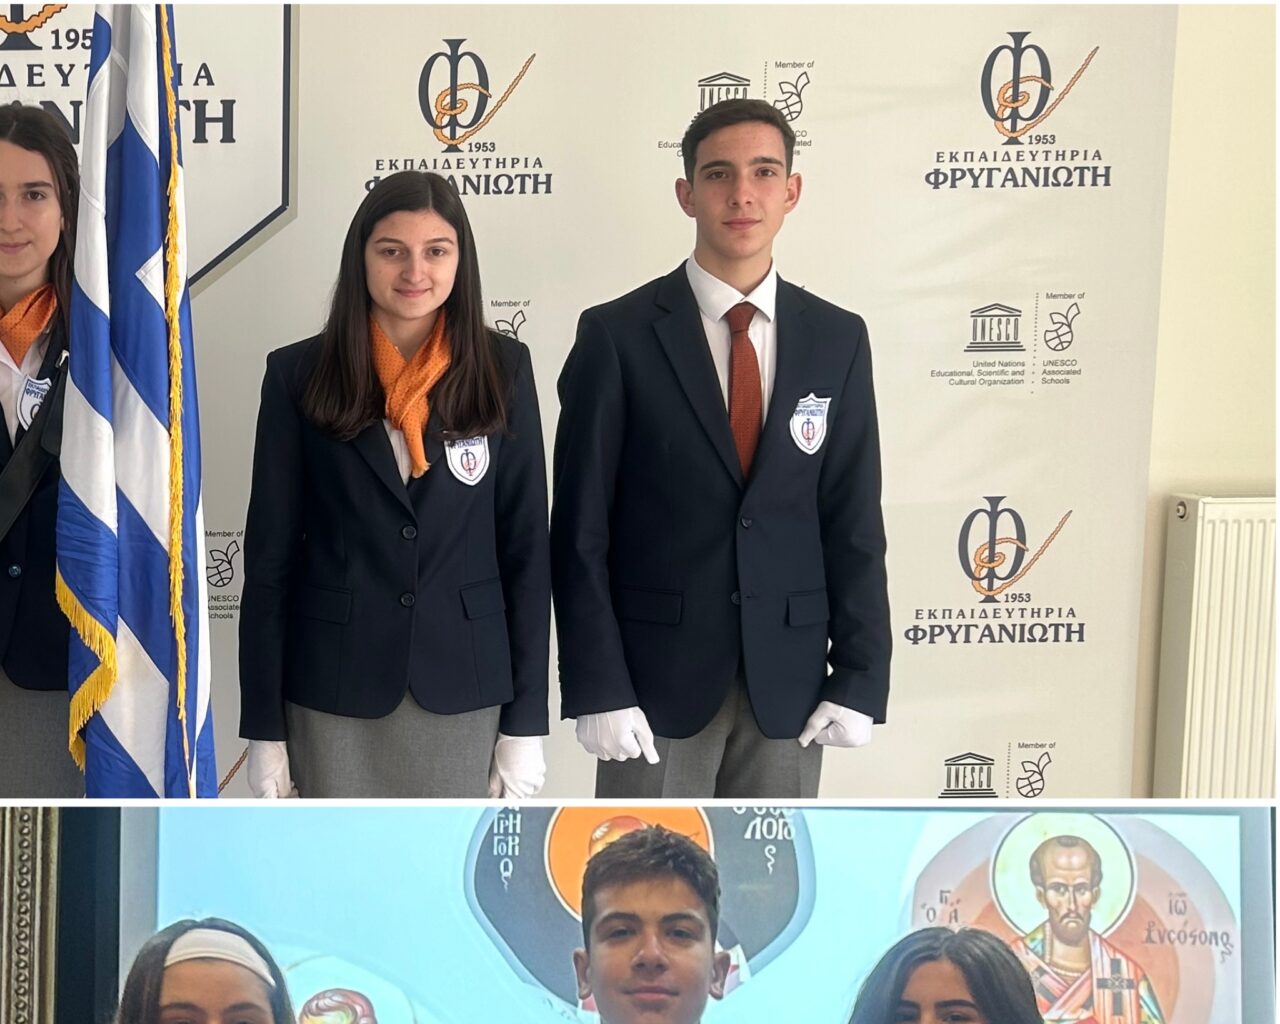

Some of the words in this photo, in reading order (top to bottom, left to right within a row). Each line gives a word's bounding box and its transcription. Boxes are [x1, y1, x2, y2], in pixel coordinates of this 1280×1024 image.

[51, 29, 93, 50] 195
[1028, 135, 1056, 144] 1953
[468, 142, 496, 152] 1953
[936, 150, 1102, 163] ΕΚΠΑΙΔΕΥΤΗΡΙΑ
[376, 157, 543, 170] ΕΚΠΑΙΔΕΥΤΗΡΙΑ
[925, 166, 1111, 189] ΦΡΥΓΑΝΙΩΤΗ
[973, 318, 1018, 341] UNESCO
[949, 378, 977, 386] Cultural
[979, 378, 1024, 387] Organization
[1004, 593, 1031, 603] 1953
[915, 607, 1076, 619] ΕΚΠΑΙΔΕΥΤΗΡΙΑ
[904, 623, 1085, 645] ΦΡΥΓΑΝΙΩΤΗ
[946, 766, 992, 789] UNESCO
